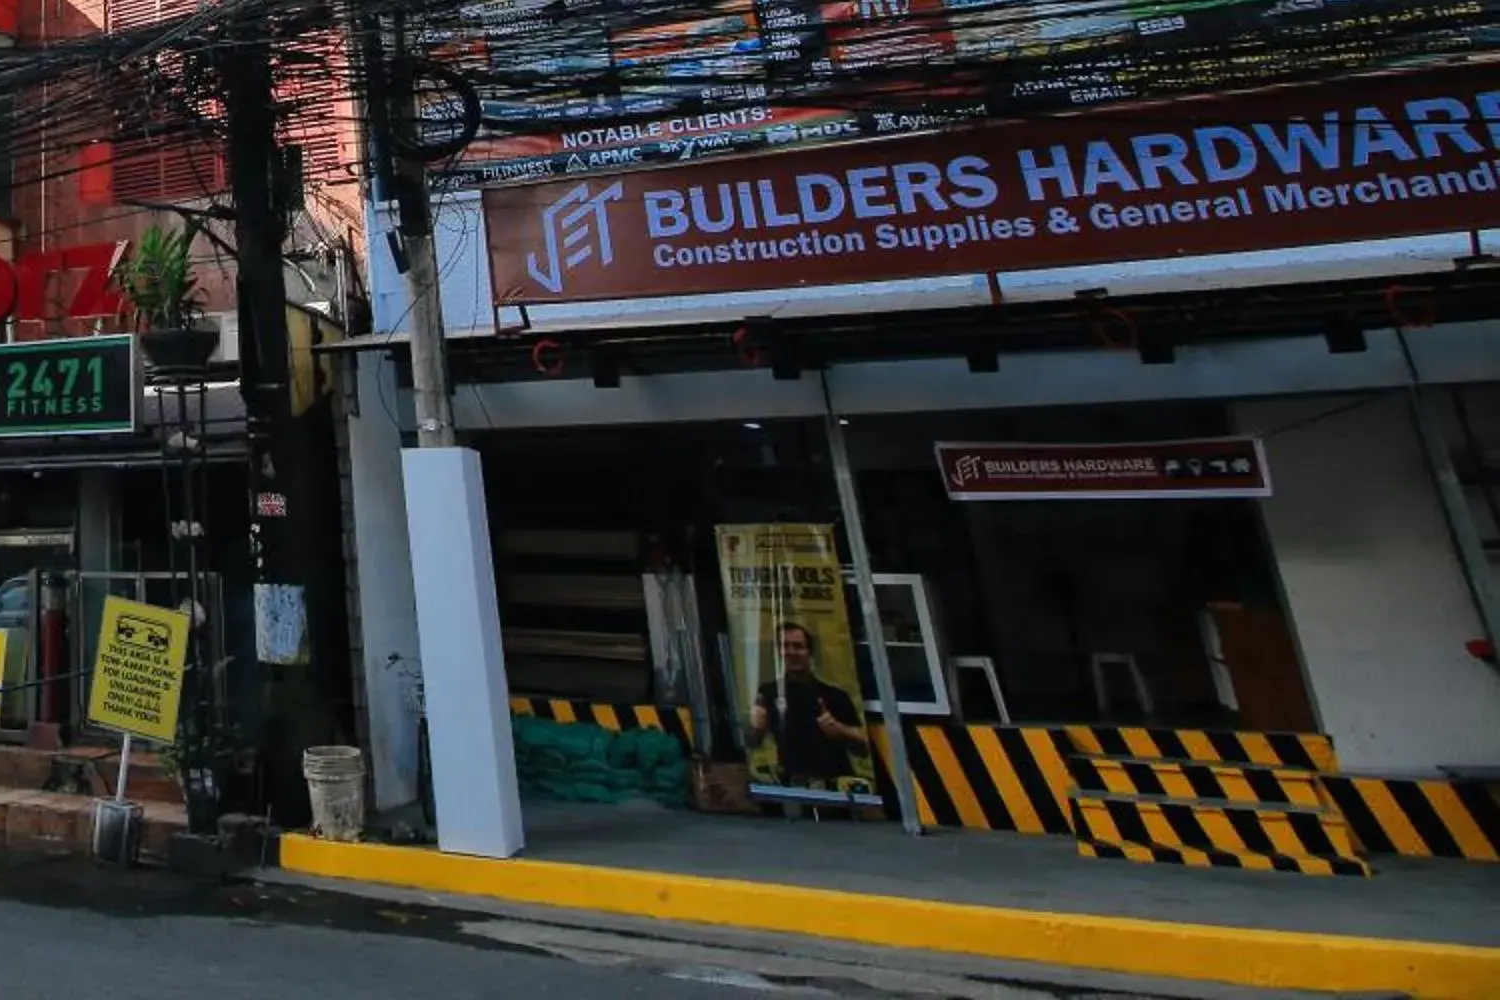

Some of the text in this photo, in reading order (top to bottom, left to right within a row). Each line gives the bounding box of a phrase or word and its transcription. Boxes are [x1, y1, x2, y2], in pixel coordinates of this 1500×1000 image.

[561, 117, 663, 149] NOTABLE
[669, 105, 775, 133] CLIENTS:
[588, 146, 643, 166] APMC
[643, 154, 999, 240] BUILDERS
[653, 230, 865, 269] Construction
[876, 212, 1036, 255] Supplies
[1046, 206, 1080, 234] &
[1088, 187, 1253, 231] General
[6, 356, 104, 399] 2471
[7, 399, 104, 418] FITNESS
[985, 459, 1060, 475] BUILDERS
[1065, 456, 1156, 473] HARDWARE
[778, 565, 835, 586] TOOLS
